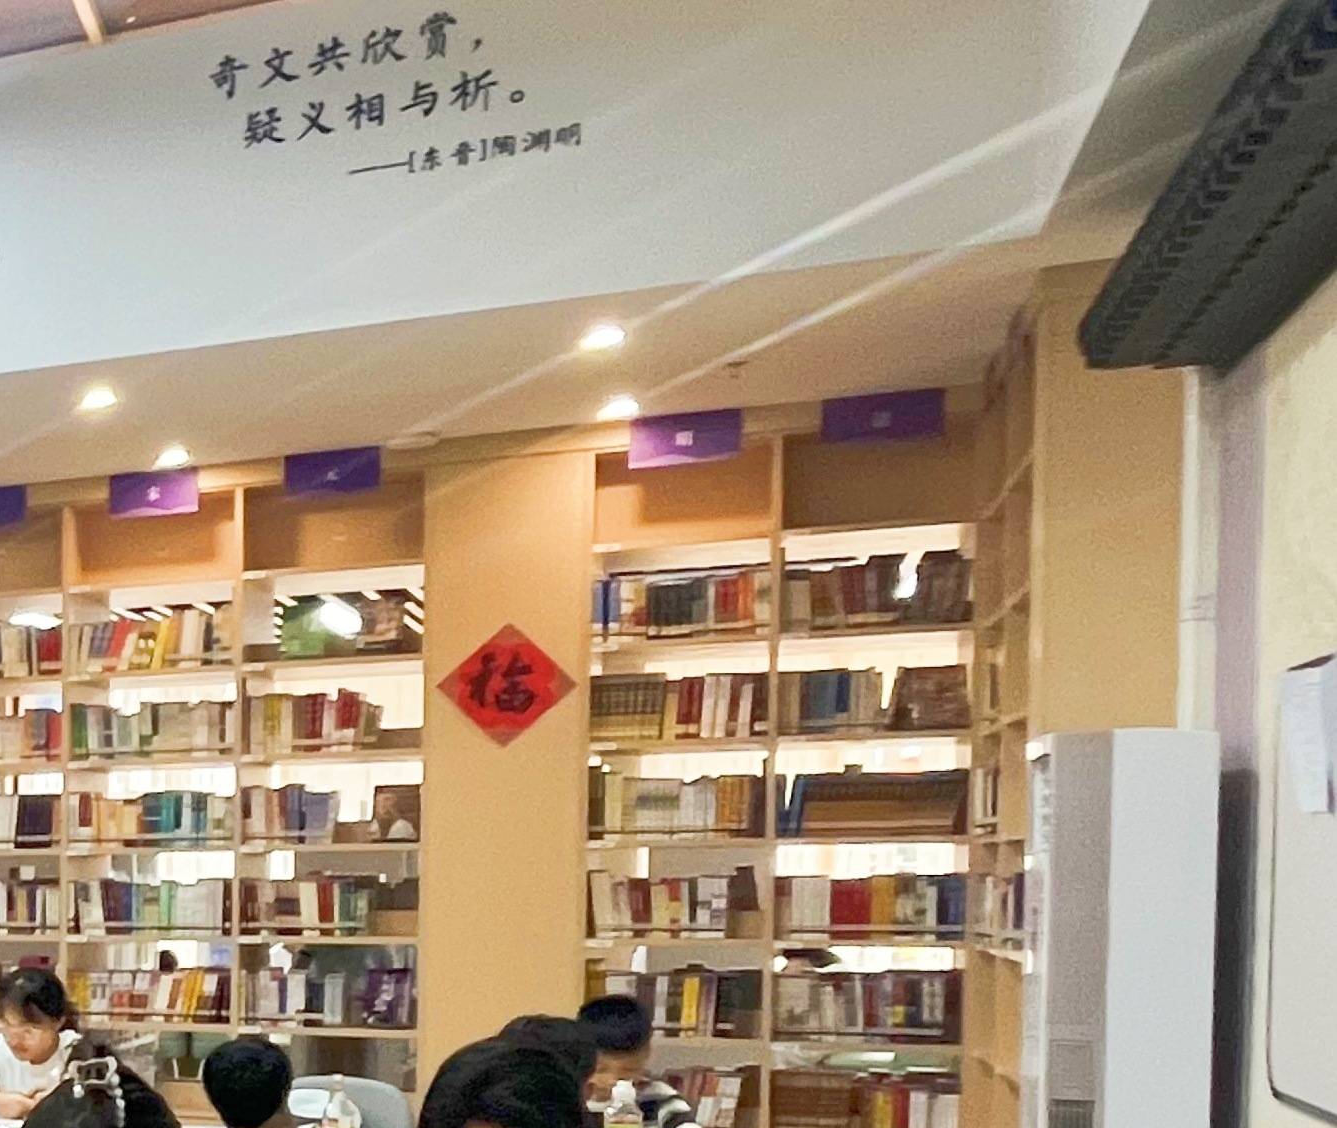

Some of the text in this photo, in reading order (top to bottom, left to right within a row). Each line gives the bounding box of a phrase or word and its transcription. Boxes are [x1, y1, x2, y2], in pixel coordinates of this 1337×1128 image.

[210, 12, 482, 99] 奇文共欣赏，
[244, 69, 525, 148] 疑义相与析。
[468, 652, 539, 714] 福
